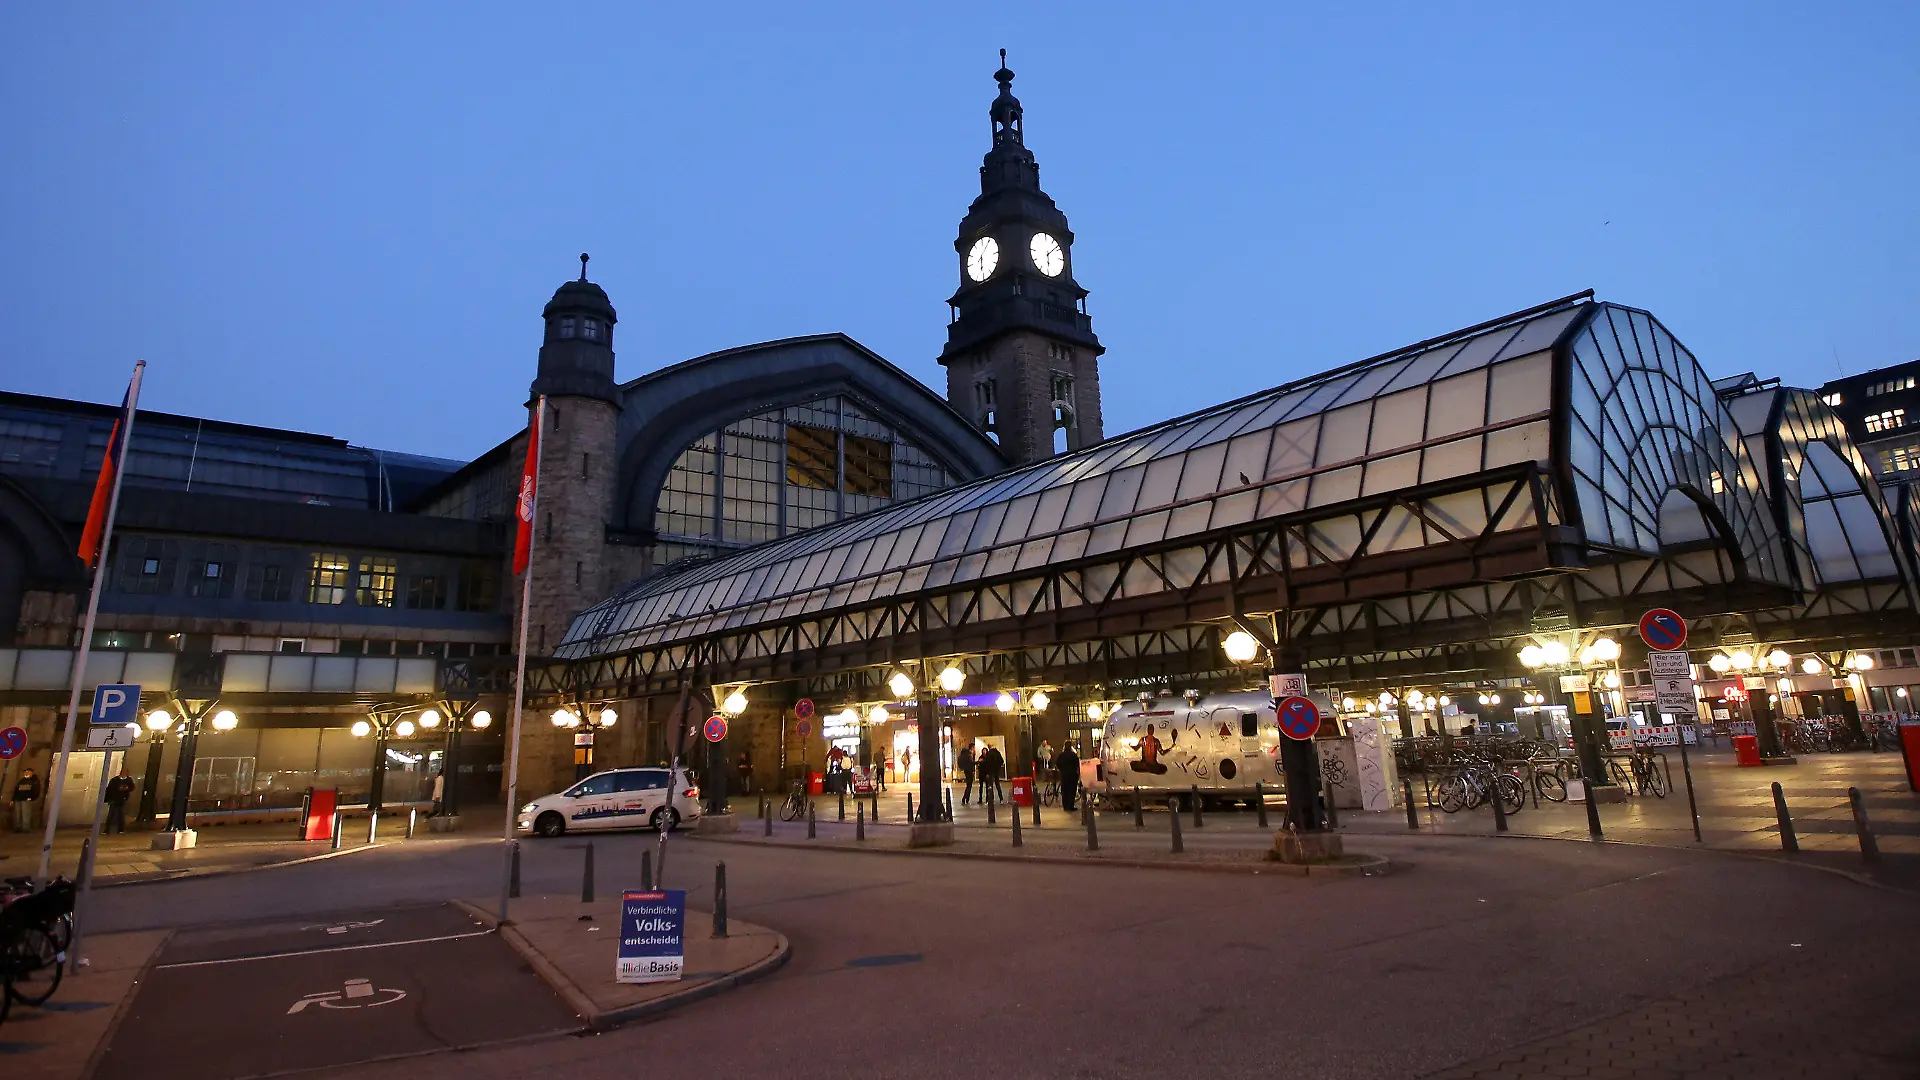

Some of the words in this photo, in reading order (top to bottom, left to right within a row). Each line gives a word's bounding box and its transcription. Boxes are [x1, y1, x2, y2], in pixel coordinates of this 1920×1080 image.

[100, 690, 126, 718] P
[627, 906, 677, 915] Verbindliche
[635, 918, 676, 932] Volks-
[624, 935, 679, 945] entscheide!
